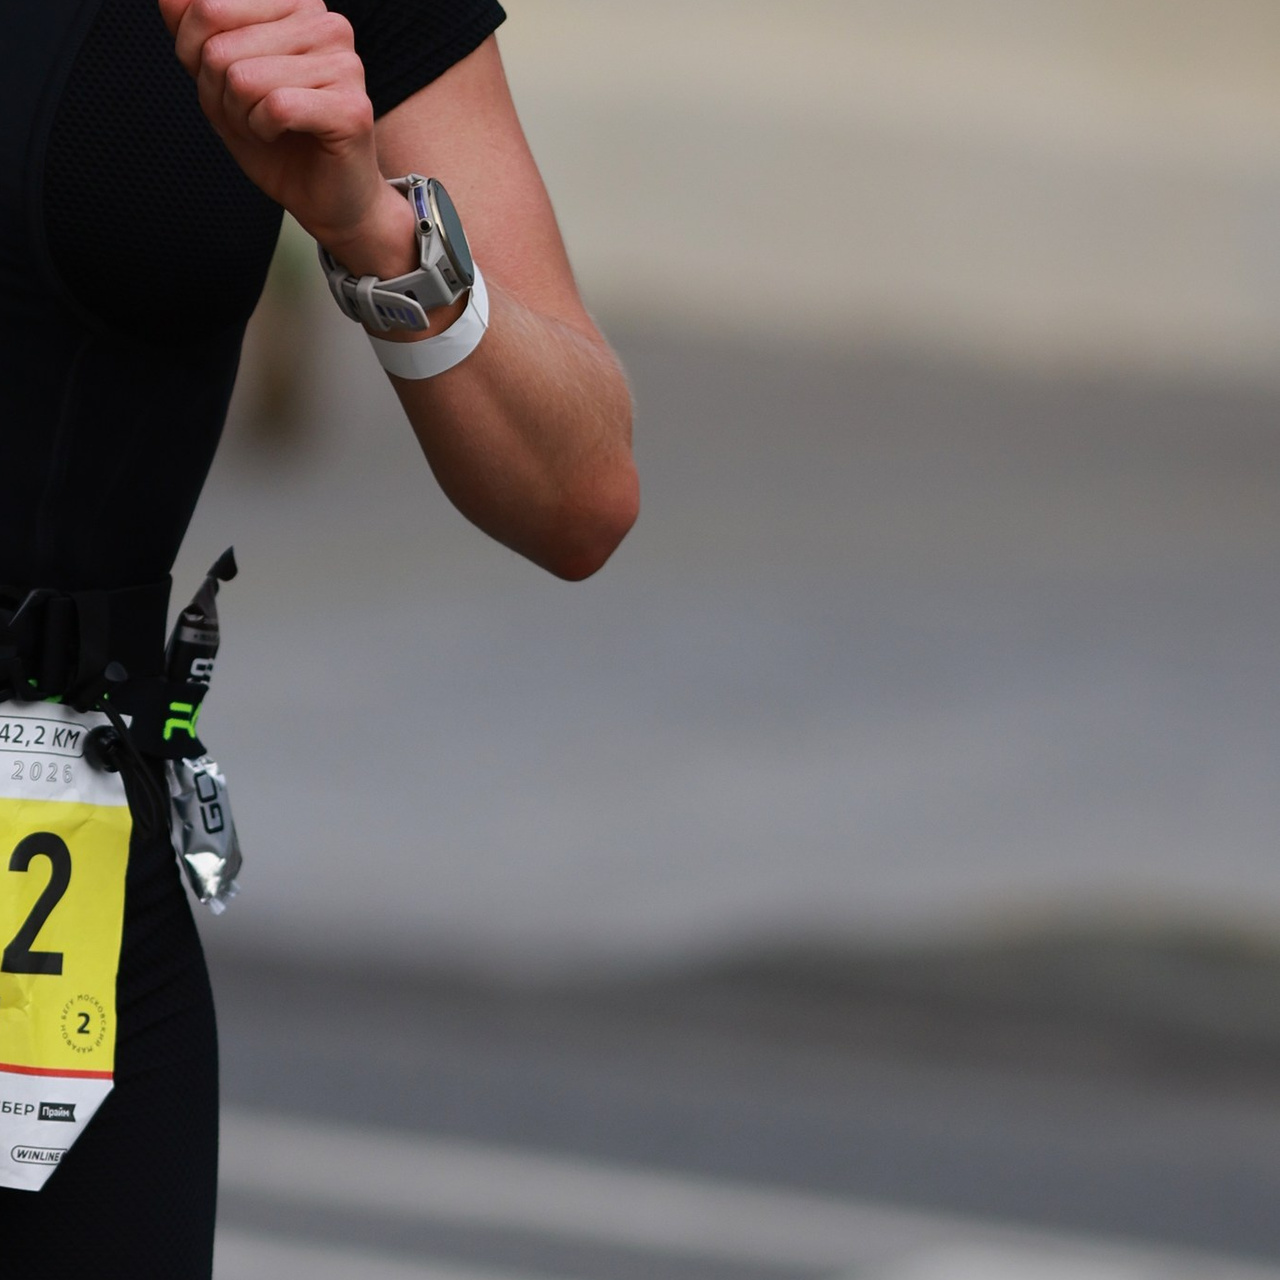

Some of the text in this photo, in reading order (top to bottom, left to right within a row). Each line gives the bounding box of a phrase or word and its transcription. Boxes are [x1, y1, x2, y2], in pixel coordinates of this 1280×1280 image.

[52, 727, 81, 750] КМ
[11, 760, 73, 784] 2026
[77, 1012, 91, 1034] 2
[41, 1106, 70, 1118] Прайм
[16, 1148, 61, 1162] WINLINE
